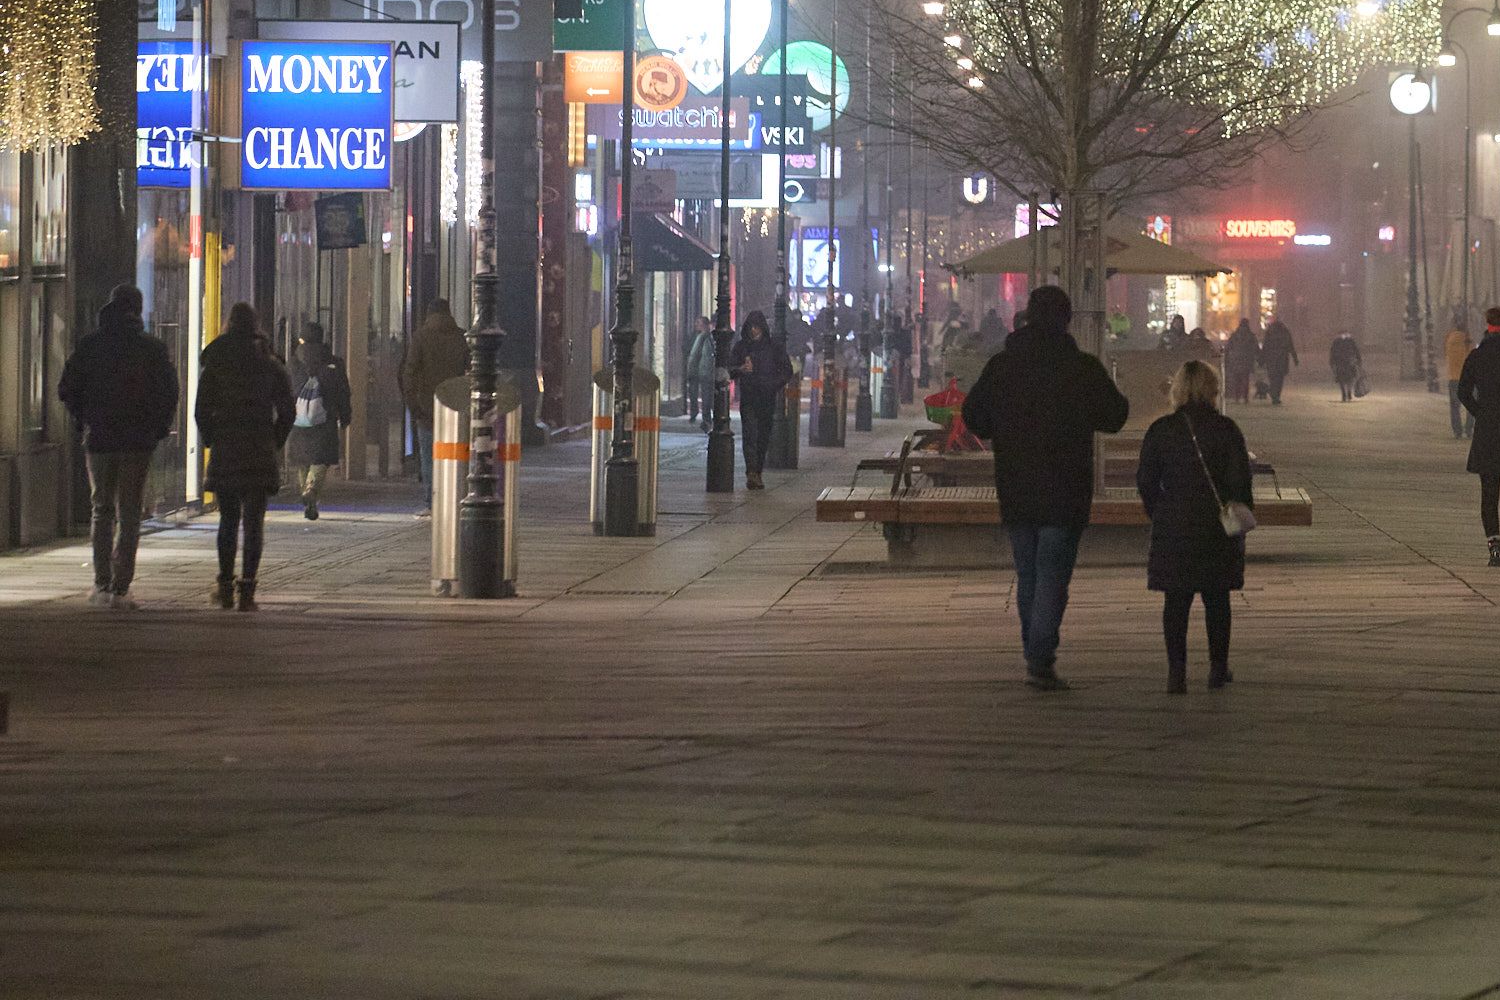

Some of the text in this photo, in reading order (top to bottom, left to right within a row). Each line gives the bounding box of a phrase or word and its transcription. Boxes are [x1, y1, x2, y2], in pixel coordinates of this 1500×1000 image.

[247, 54, 388, 94] MONEY
[245, 126, 386, 170] CHANGE
[962, 176, 987, 204] U
[1226, 219, 1295, 238] SOUVENIRS
